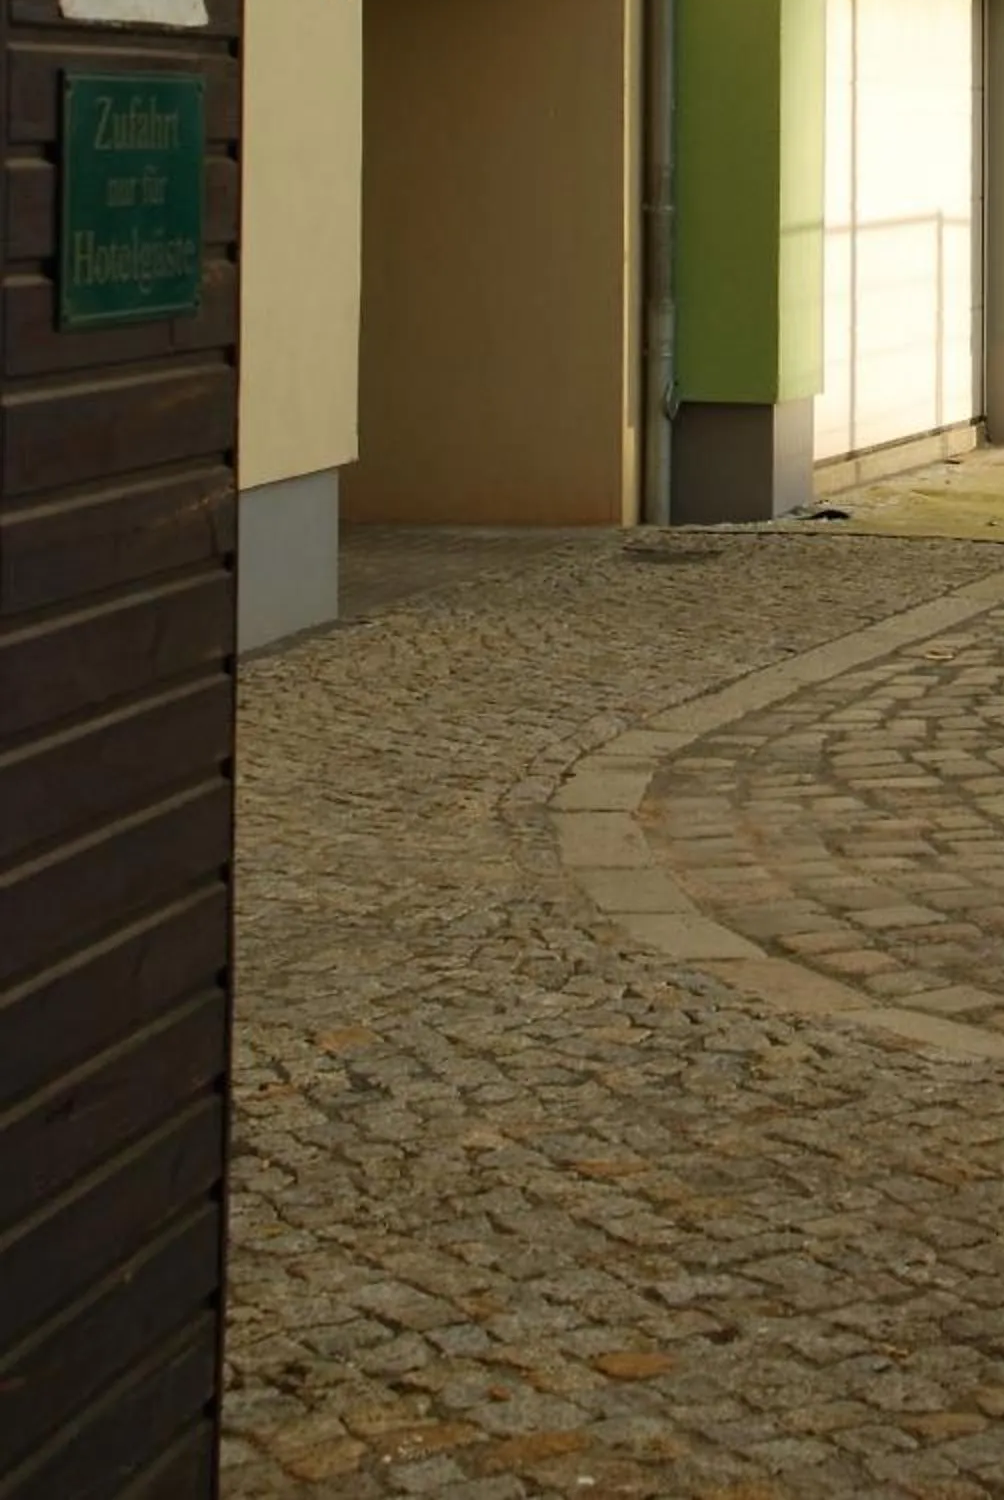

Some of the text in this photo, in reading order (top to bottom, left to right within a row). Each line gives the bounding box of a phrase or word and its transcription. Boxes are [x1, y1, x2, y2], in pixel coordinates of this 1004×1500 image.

[93, 95, 180, 151] Zufahrt
[106, 163, 169, 208] nur für
[72, 227, 197, 297] Hotelgäste
